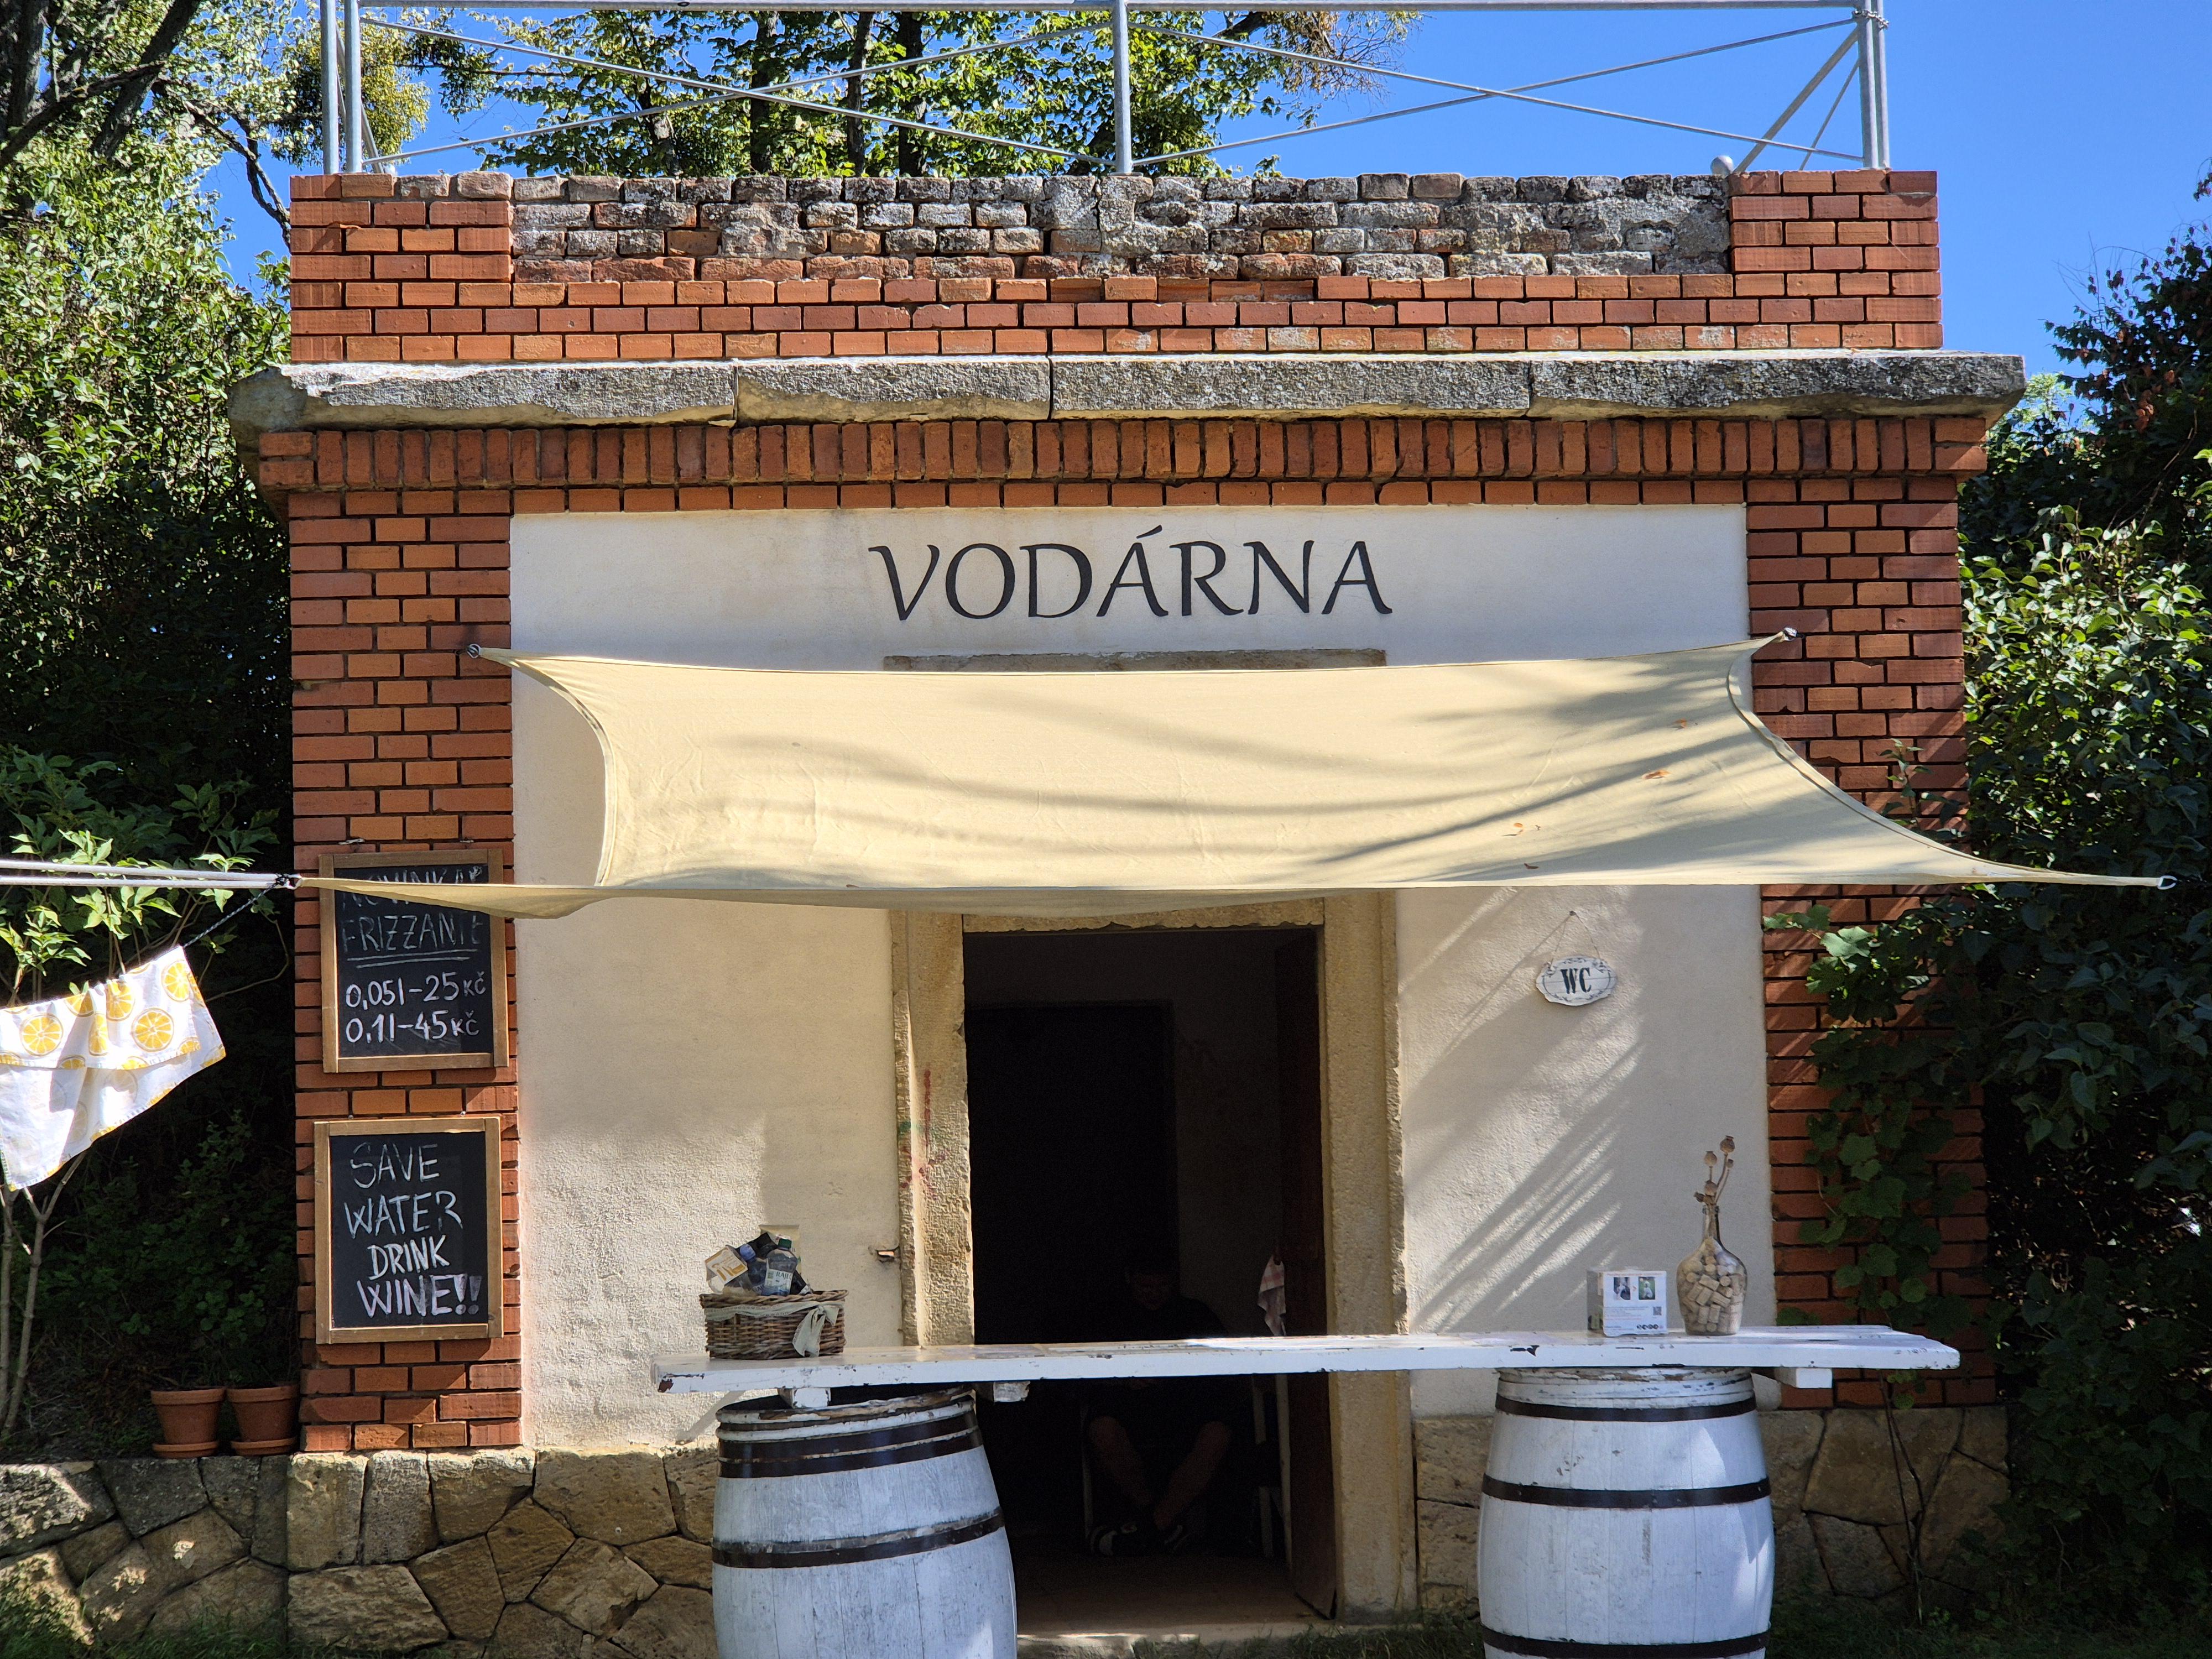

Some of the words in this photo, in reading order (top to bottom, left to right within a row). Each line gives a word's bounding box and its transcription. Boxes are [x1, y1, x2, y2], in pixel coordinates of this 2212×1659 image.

[868, 524, 1393, 621] VODÁRNA
[341, 912, 484, 953] FRIZZANTE
[1560, 967, 1592, 994] WC
[350, 1141, 440, 1189] SAVE
[343, 1190, 463, 1239] WATER
[367, 1234, 450, 1281] DRINK
[357, 1273, 482, 1318] WINE!!
